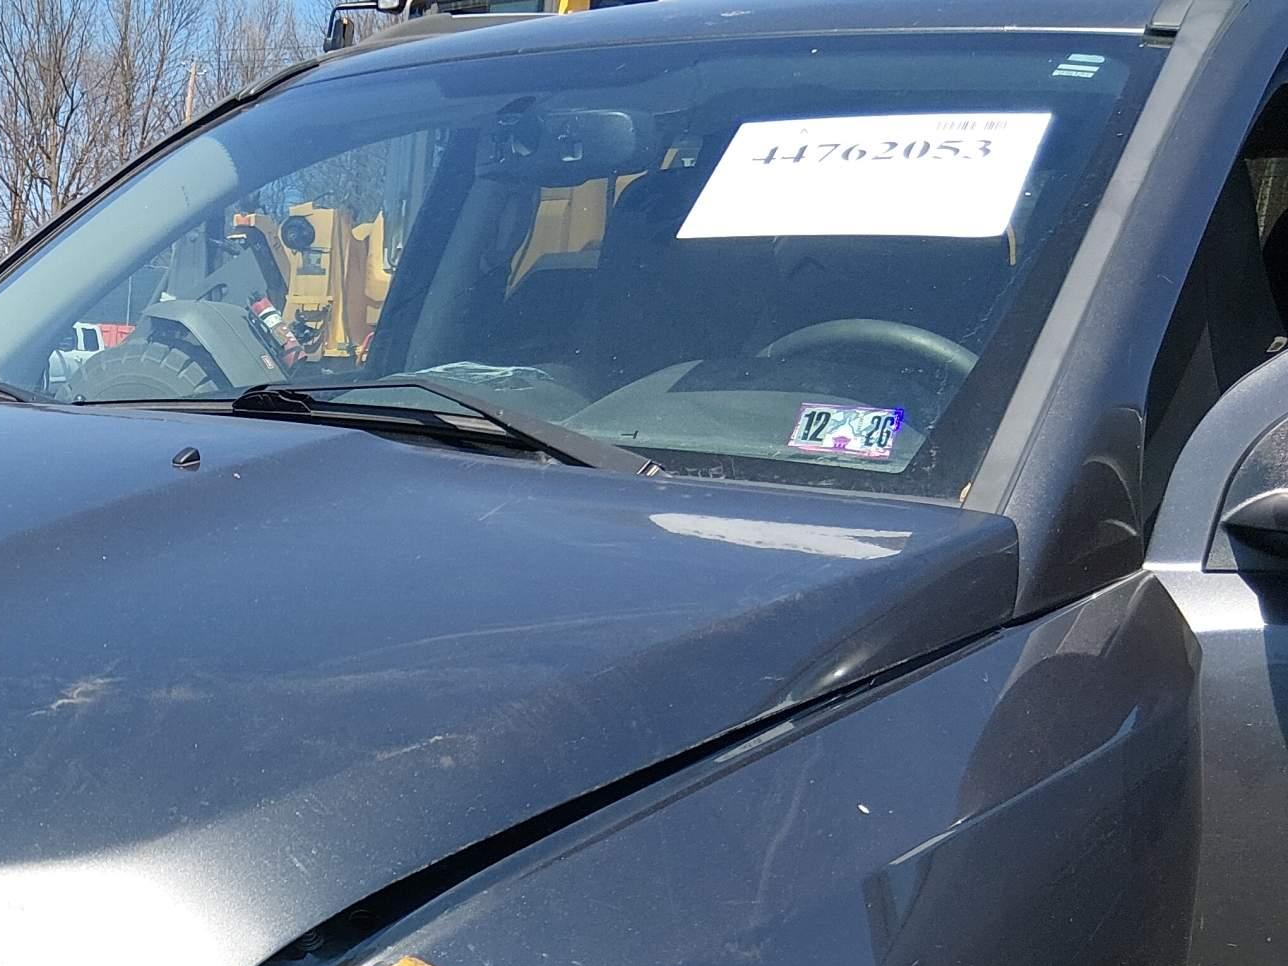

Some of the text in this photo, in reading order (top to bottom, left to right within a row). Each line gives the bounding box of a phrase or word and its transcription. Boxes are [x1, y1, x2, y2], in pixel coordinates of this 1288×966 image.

[752, 139, 993, 165] 44762053
[800, 410, 894, 448] 12 26
